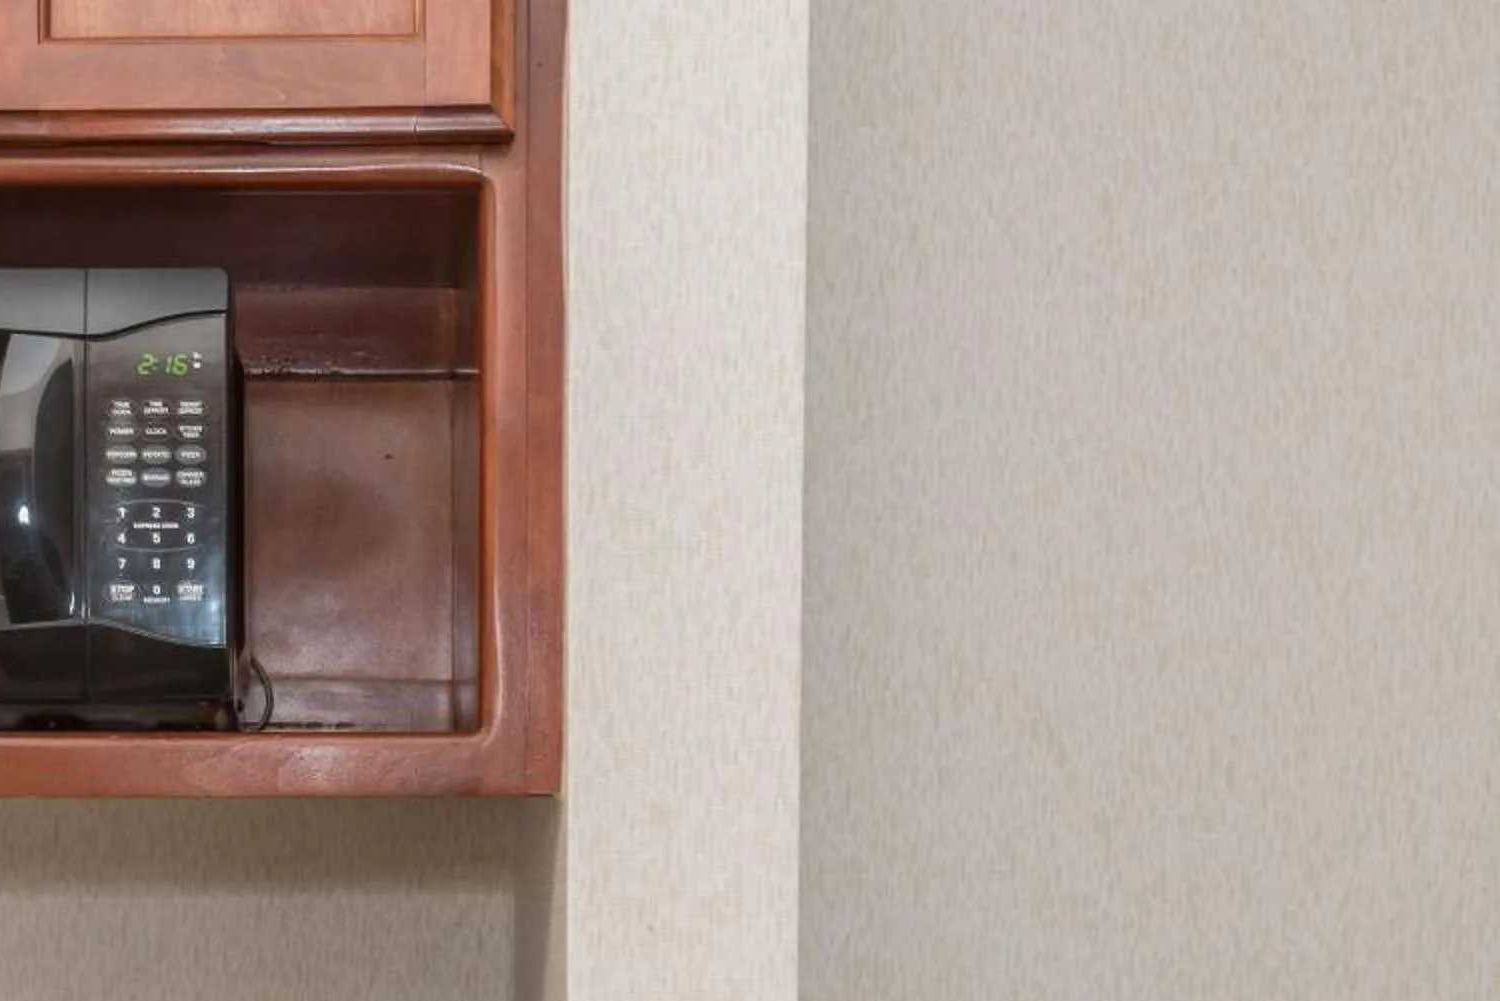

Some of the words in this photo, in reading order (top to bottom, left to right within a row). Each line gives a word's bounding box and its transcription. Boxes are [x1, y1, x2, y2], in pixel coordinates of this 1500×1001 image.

[117, 507, 127, 519] 1
[152, 506, 161, 519] 2
[187, 507, 196, 519] 3
[117, 532, 127, 544] 4
[152, 531, 161, 544] 5
[187, 532, 196, 544] 6
[118, 557, 127, 570] 7
[152, 557, 161, 569] 8
[186, 557, 196, 570] 9
